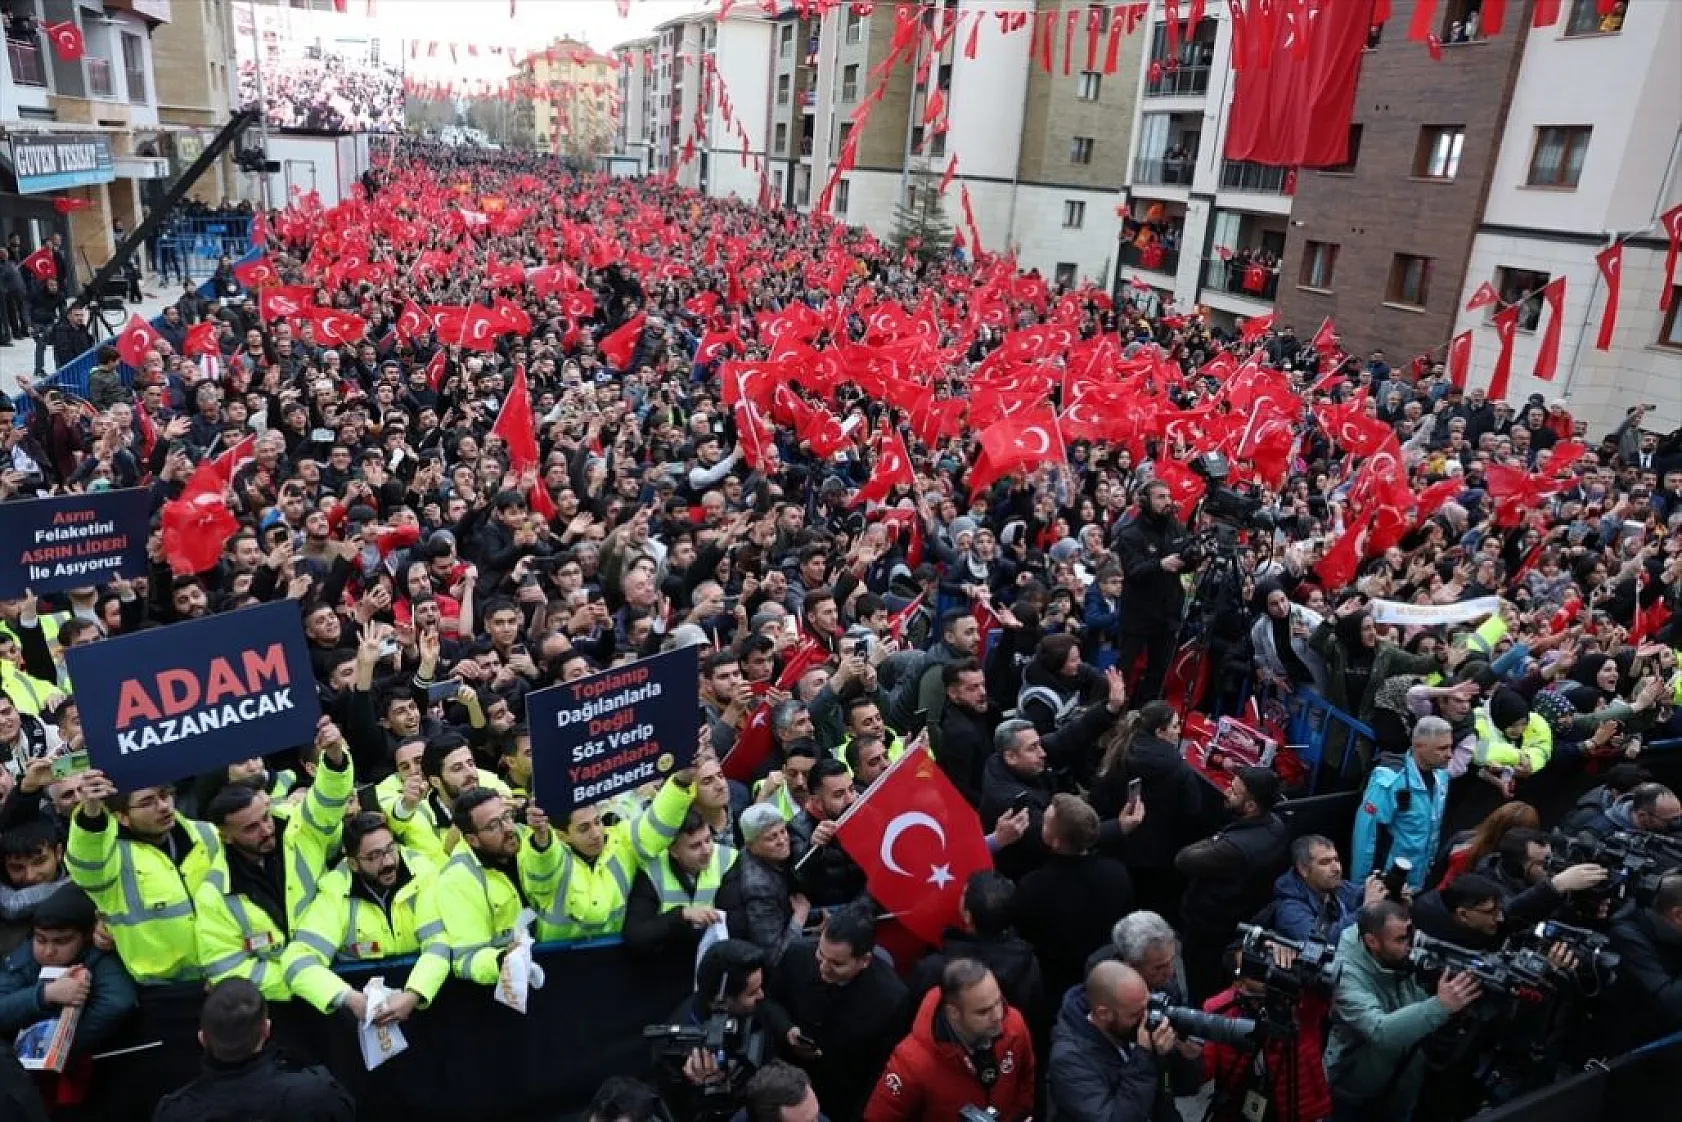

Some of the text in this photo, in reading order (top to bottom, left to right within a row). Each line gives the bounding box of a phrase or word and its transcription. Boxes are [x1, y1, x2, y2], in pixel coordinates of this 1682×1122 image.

[35, 520, 114, 544] Felaketini
[53, 509, 96, 525] Asrın
[20, 534, 128, 565] ASRIN LİDERİ
[54, 555, 122, 577] Aşıyoruz
[116, 643, 290, 729] ADAM
[572, 667, 649, 700] Toplanıp
[117, 687, 294, 754] KAZANACAK
[557, 681, 662, 727] Dağılanlarla
[588, 707, 635, 737] Değil
[572, 722, 654, 763] Söz Verip
[568, 740, 660, 783] Yapanlarla
[573, 761, 655, 804] Beraberiz
